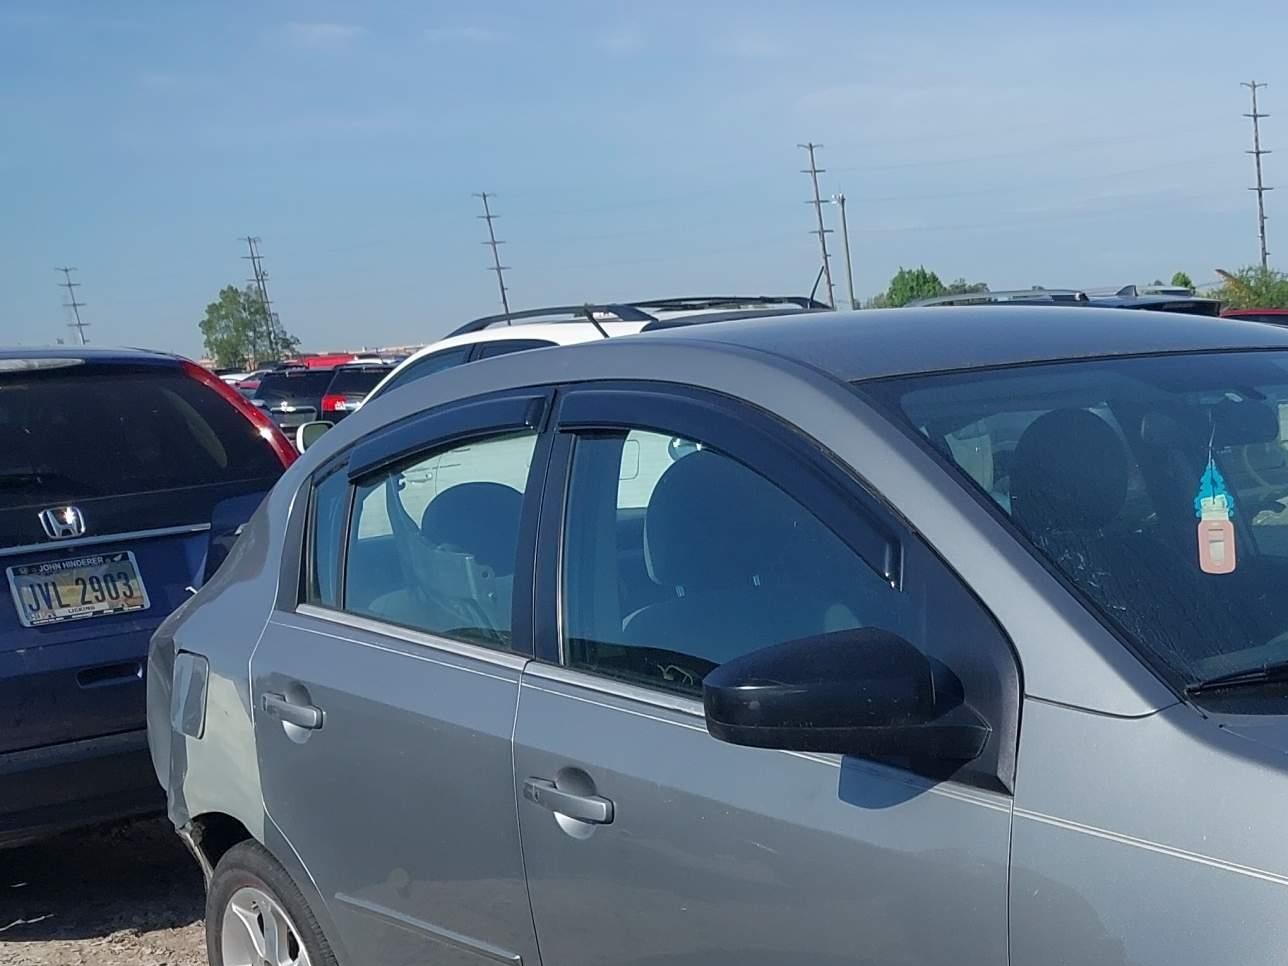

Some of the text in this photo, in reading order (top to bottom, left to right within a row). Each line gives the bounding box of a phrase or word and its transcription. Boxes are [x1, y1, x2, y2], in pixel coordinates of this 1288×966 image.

[39, 561, 61, 573] JOHN
[28, 571, 134, 612] JVL 2903
